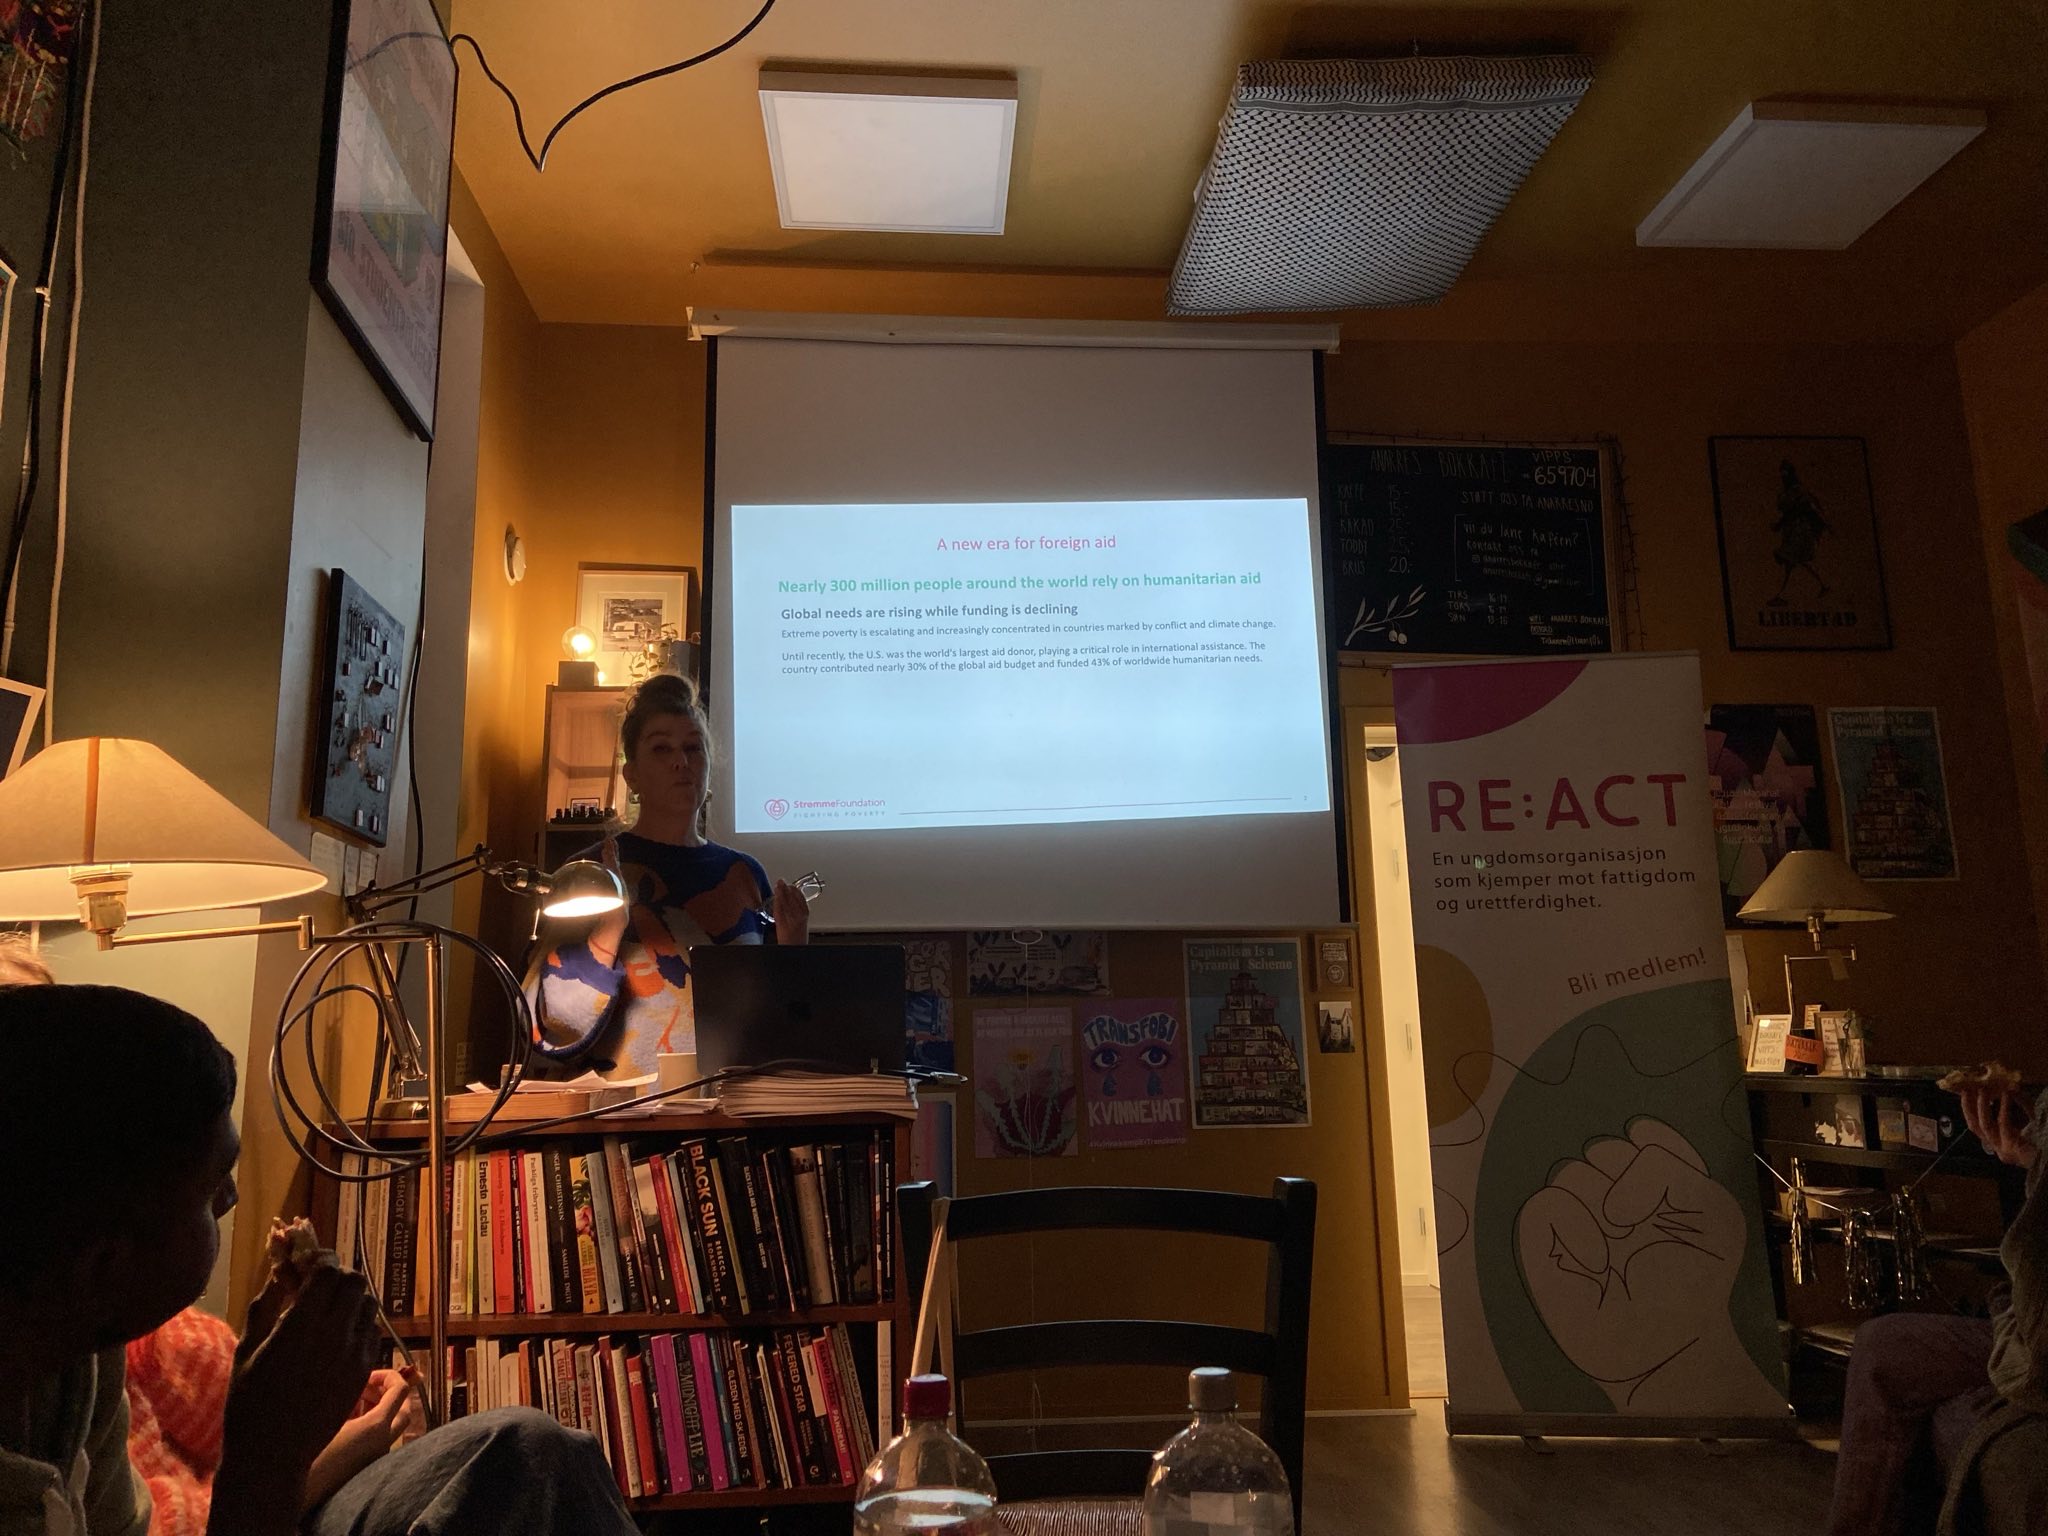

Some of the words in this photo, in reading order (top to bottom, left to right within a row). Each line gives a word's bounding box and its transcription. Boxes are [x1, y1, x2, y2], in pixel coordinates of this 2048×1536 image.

[1534, 465, 1596, 489] 659704
[936, 538, 948, 551] A
[952, 540, 983, 551] new
[987, 540, 1010, 552] era
[1015, 536, 1036, 550] for
[1039, 536, 1090, 552] foreign
[1095, 535, 1116, 548] aid
[778, 579, 827, 595] Nearly
[830, 579, 857, 592] 300
[860, 578, 910, 592] million
[914, 577, 963, 593] people
[966, 576, 1017, 590] around
[1020, 576, 1044, 589] the
[1047, 575, 1088, 588] world
[1092, 574, 1118, 590] rely
[1121, 577, 1140, 586] on
[1143, 572, 1236, 586] humanitarian
[1240, 571, 1261, 584] aid
[781, 608, 822, 620] Global
[825, 607, 862, 618] needs
[865, 609, 885, 618] are
[888, 606, 922, 620] rising
[925, 605, 958, 617] while
[961, 604, 1009, 618] funding
[1011, 604, 1021, 615] is
[1024, 603, 1078, 616] declining
[782, 630, 820, 638] Extreme
[822, 629, 858, 639] poverty
[860, 628, 868, 637] is
[869, 627, 915, 638] escalating
[916, 626, 934, 636] and
[936, 625, 990, 636] increasingly
[991, 624, 1050, 634] concentrated
[1052, 624, 1061, 632] in
[1063, 623, 1105, 632] countries
[1106, 622, 1140, 631] marked
[1142, 622, 1153, 632] by
[1154, 620, 1188, 630] conflict
[1189, 620, 1206, 629] and
[1208, 619, 1240, 628] climate
[1242, 619, 1276, 630] change.
[782, 652, 804, 661] Until
[806, 651, 846, 661] recently,
[848, 650, 864, 660] the
[866, 650, 884, 659] U.S.
[906, 649, 922, 658] the
[924, 648, 957, 658] world's
[959, 648, 989, 659] largest
[991, 647, 1006, 656] aid
[1007, 647, 1036, 657] donor,
[1038, 646, 1070, 657] playing
[1080, 644, 1110, 654] critical
[1112, 644, 1129, 654] role
[1131, 644, 1140, 653] in
[1142, 642, 1198, 653] international
[1200, 642, 1247, 652] assistance.
[1248, 641, 1266, 651] The
[782, 666, 818, 675] country
[820, 663, 874, 673] contributed
[876, 662, 905, 673] nearly
[907, 662, 927, 671] 30%
[928, 661, 939, 671] of
[940, 661, 956, 670] the
[958, 658, 986, 672] global
[988, 660, 1002, 669] aid
[1004, 660, 1036, 671] budget
[1038, 655, 1055, 668] and
[1057, 655, 1089, 668] funded
[1091, 658, 1110, 667] 43%
[1112, 656, 1122, 666] of
[1123, 656, 1171, 666] worldwide
[1172, 654, 1232, 664] humanitarian
[1234, 654, 1263, 663] needs.
[1428, 774, 1687, 833] RE:ACT
[1433, 852, 1454, 867] En
[1461, 847, 1666, 868] ungdomsorganisasjon
[1435, 875, 1472, 889] som
[1477, 873, 1552, 890] kjemper
[1558, 873, 1595, 886] mot
[1600, 869, 1697, 888] fattigdom
[1436, 898, 1458, 913] og
[1466, 894, 1602, 912] urettferdighet.
[1190, 957, 1240, 972] Pyramid
[1248, 957, 1293, 970] Scheme
[1567, 971, 1597, 996] Bli
[1606, 947, 1708, 988] medlem!
[1083, 1013, 1178, 1047] TRANSFOBI
[1088, 1098, 1185, 1127] KVINNEHAT
[478, 1161, 489, 1201] Ernesto
[690, 1144, 712, 1203] BLACK
[394, 1175, 406, 1218] MEMORY
[554, 1173, 565, 1221] CHRISTENSEN
[479, 1203, 489, 1238] Laclau
[700, 1202, 719, 1237] SUN
[392, 1222, 404, 1260] CALLED
[715, 1240, 725, 1278] REBECCA
[390, 1261, 401, 1297] EMPIRE
[782, 1334, 800, 1384] FEVERED
[792, 1383, 807, 1414] STAR
[679, 1371, 702, 1433] MIDNIGHT
[732, 1404, 742, 1426] MED
[688, 1432, 705, 1459] LIE
[736, 1425, 749, 1459] SKJEDEN
